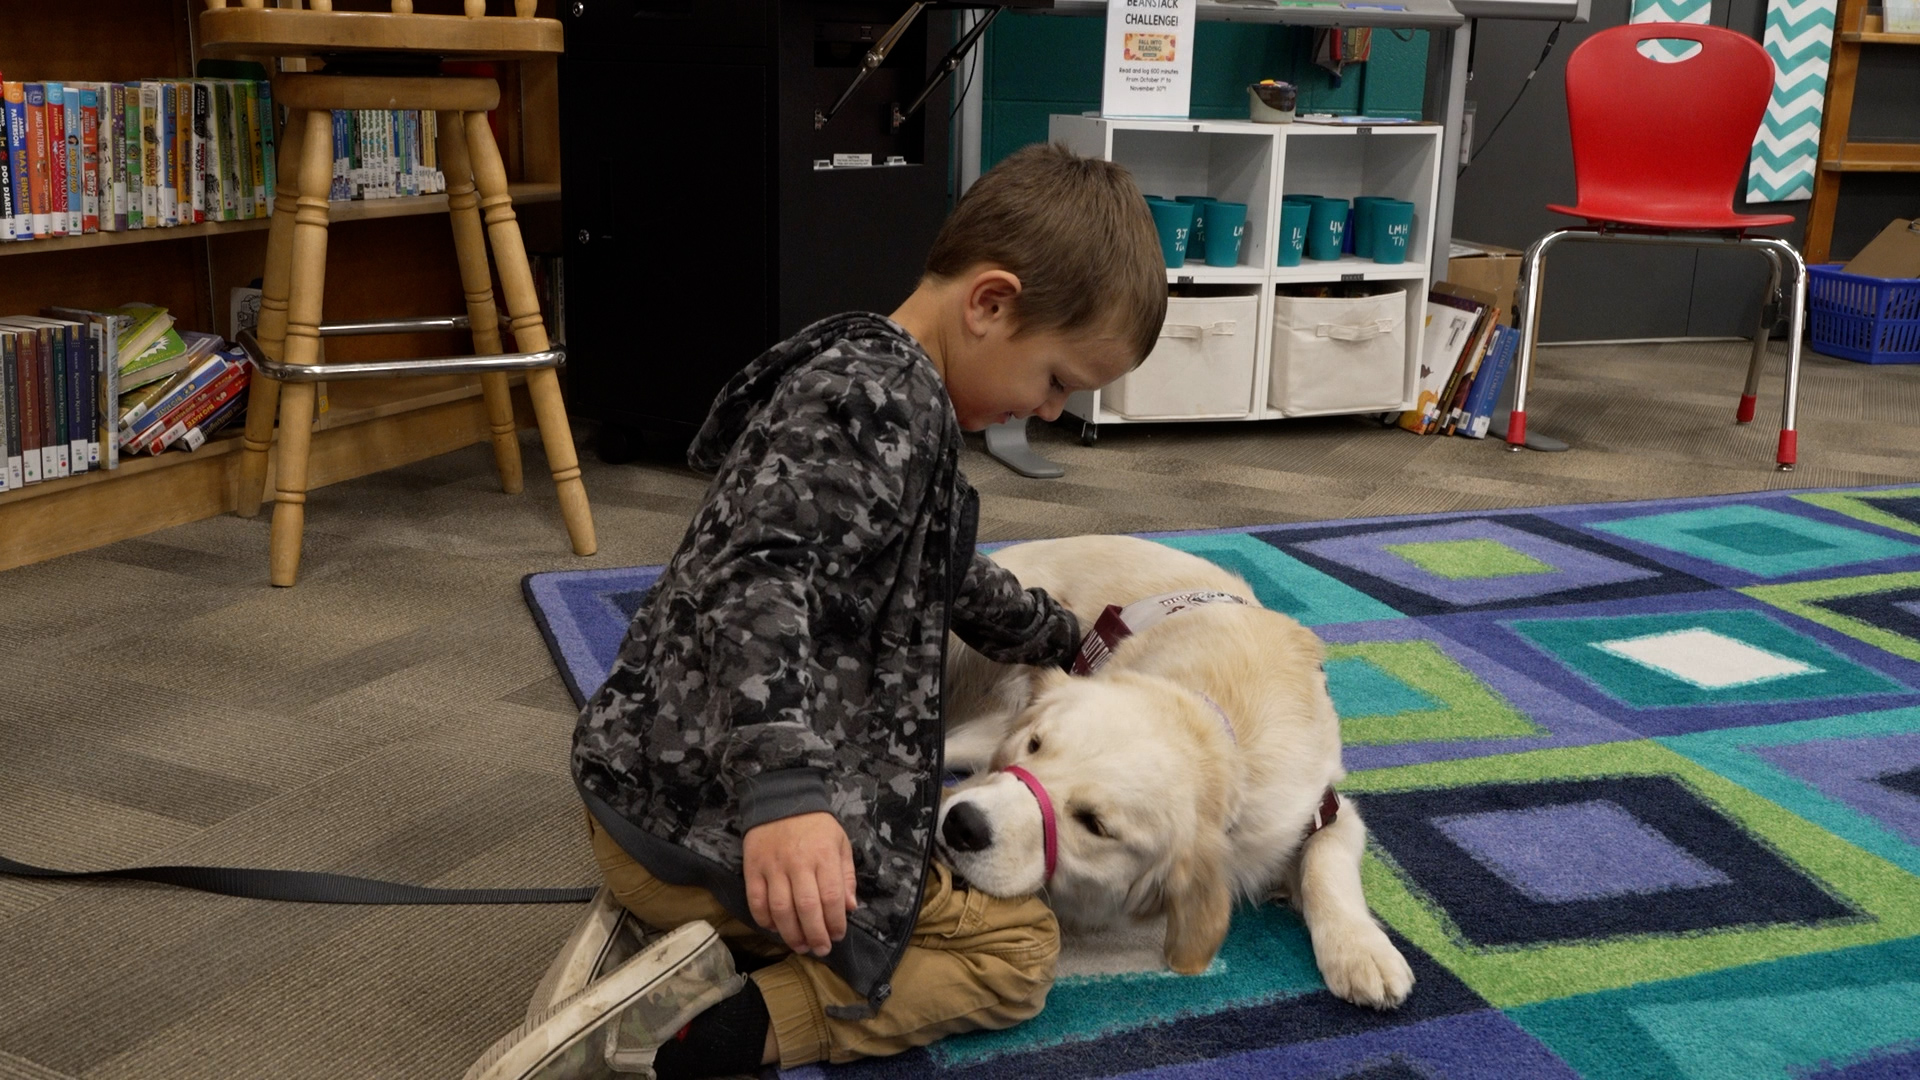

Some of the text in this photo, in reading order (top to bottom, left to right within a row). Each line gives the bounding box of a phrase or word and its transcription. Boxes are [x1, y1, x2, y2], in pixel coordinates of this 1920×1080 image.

[1125, 13, 1178, 26] CHALLENGE!
[11, 108, 19, 146] PATTERSON
[35, 111, 44, 157] JAMES PATTERSON
[58, 140, 66, 168] WORD
[1, 166, 12, 219] DOG DIARIES
[19, 150, 30, 214] MAX EINSTEIN
[60, 178, 68, 212] MOUSE
[1388, 224, 1408, 235] LMH
[1392, 236, 1404, 246] Th
[1487, 369, 1501, 401] STORIES
[186, 411, 204, 428] NATE
[202, 403, 215, 416] BIG
